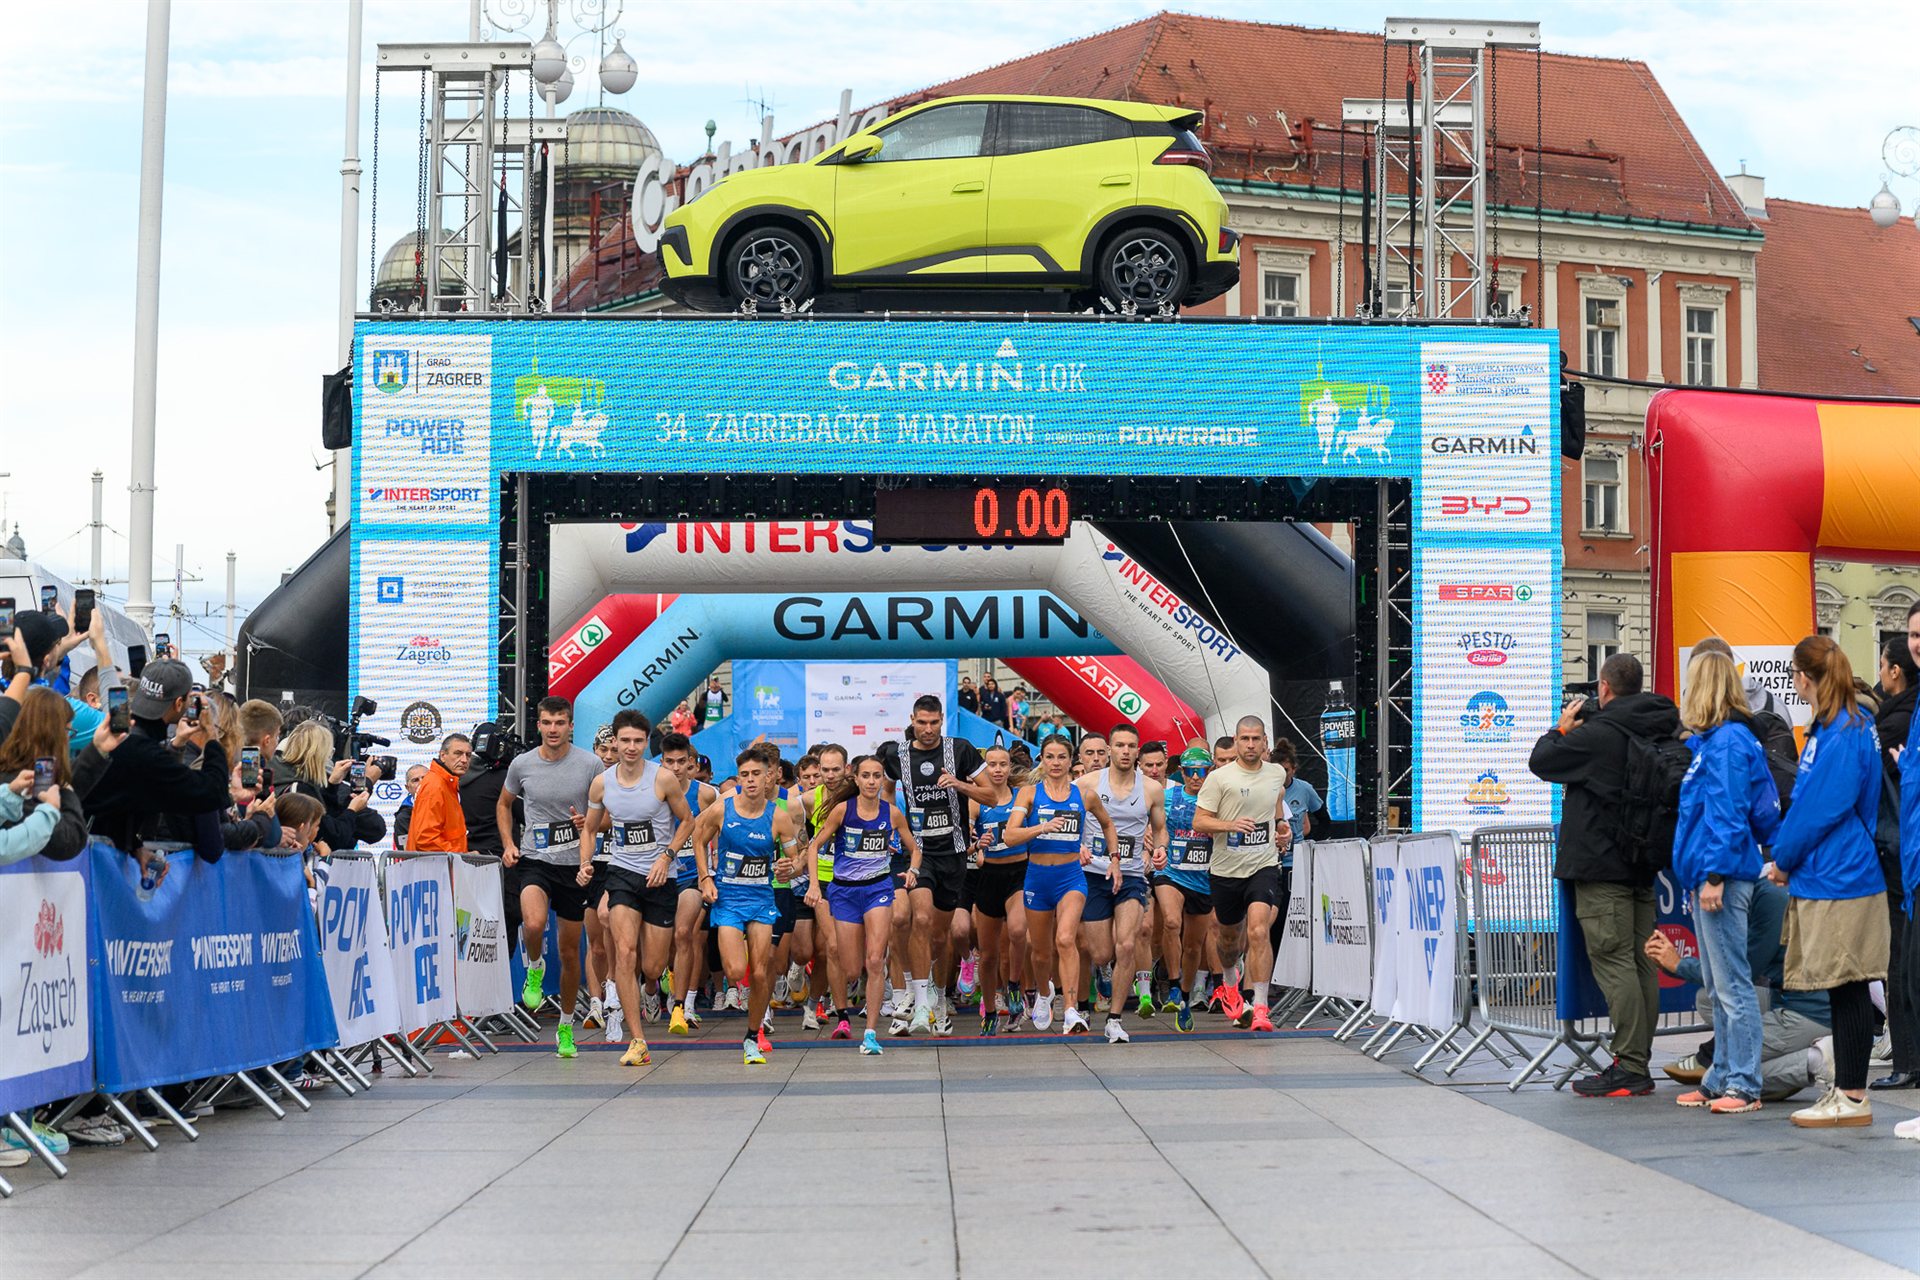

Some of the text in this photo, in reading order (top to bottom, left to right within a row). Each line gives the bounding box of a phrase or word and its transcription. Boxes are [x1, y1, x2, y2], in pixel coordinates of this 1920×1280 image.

[427, 373, 482, 386] ZAGREB
[828, 361, 1088, 392] GARMIN 10K
[385, 419, 465, 437] POWER
[656, 412, 694, 443] 34.
[706, 405, 880, 443] ZAGREBAČKI
[897, 413, 1035, 444] MARATON
[1118, 426, 1258, 446] POWERADE
[421, 438, 464, 455] ADE
[1431, 437, 1536, 454] GARMIN
[384, 488, 482, 501] INTERSPORT
[974, 487, 1068, 538] 0.00
[1442, 496, 1531, 515] BYD
[677, 520, 1013, 553] INTERS
[1456, 587, 1512, 598] SPAR
[773, 596, 1088, 641] GARMIN
[1119, 559, 1240, 662] INTERSPORT
[1123, 589, 1196, 652] THE HEART OF SPORT
[1461, 631, 1512, 651] PESTO
[396, 646, 451, 665] Zagreb
[549, 643, 582, 679] AR
[616, 627, 699, 707] GARMIN
[1750, 660, 1792, 673] WORL
[1324, 721, 1355, 731] POWER
[1338, 729, 1356, 738] ADE
[927, 814, 948, 828] 4818
[554, 828, 574, 843] 4141
[628, 829, 649, 843] 5017
[863, 837, 885, 850] 5021
[1244, 830, 1267, 844] 5022
[1187, 850, 1208, 863] 4831
[741, 863, 766, 876] 4054
[201, 933, 253, 969] INTERSPORT
[17, 957, 77, 1053] Zagreb
